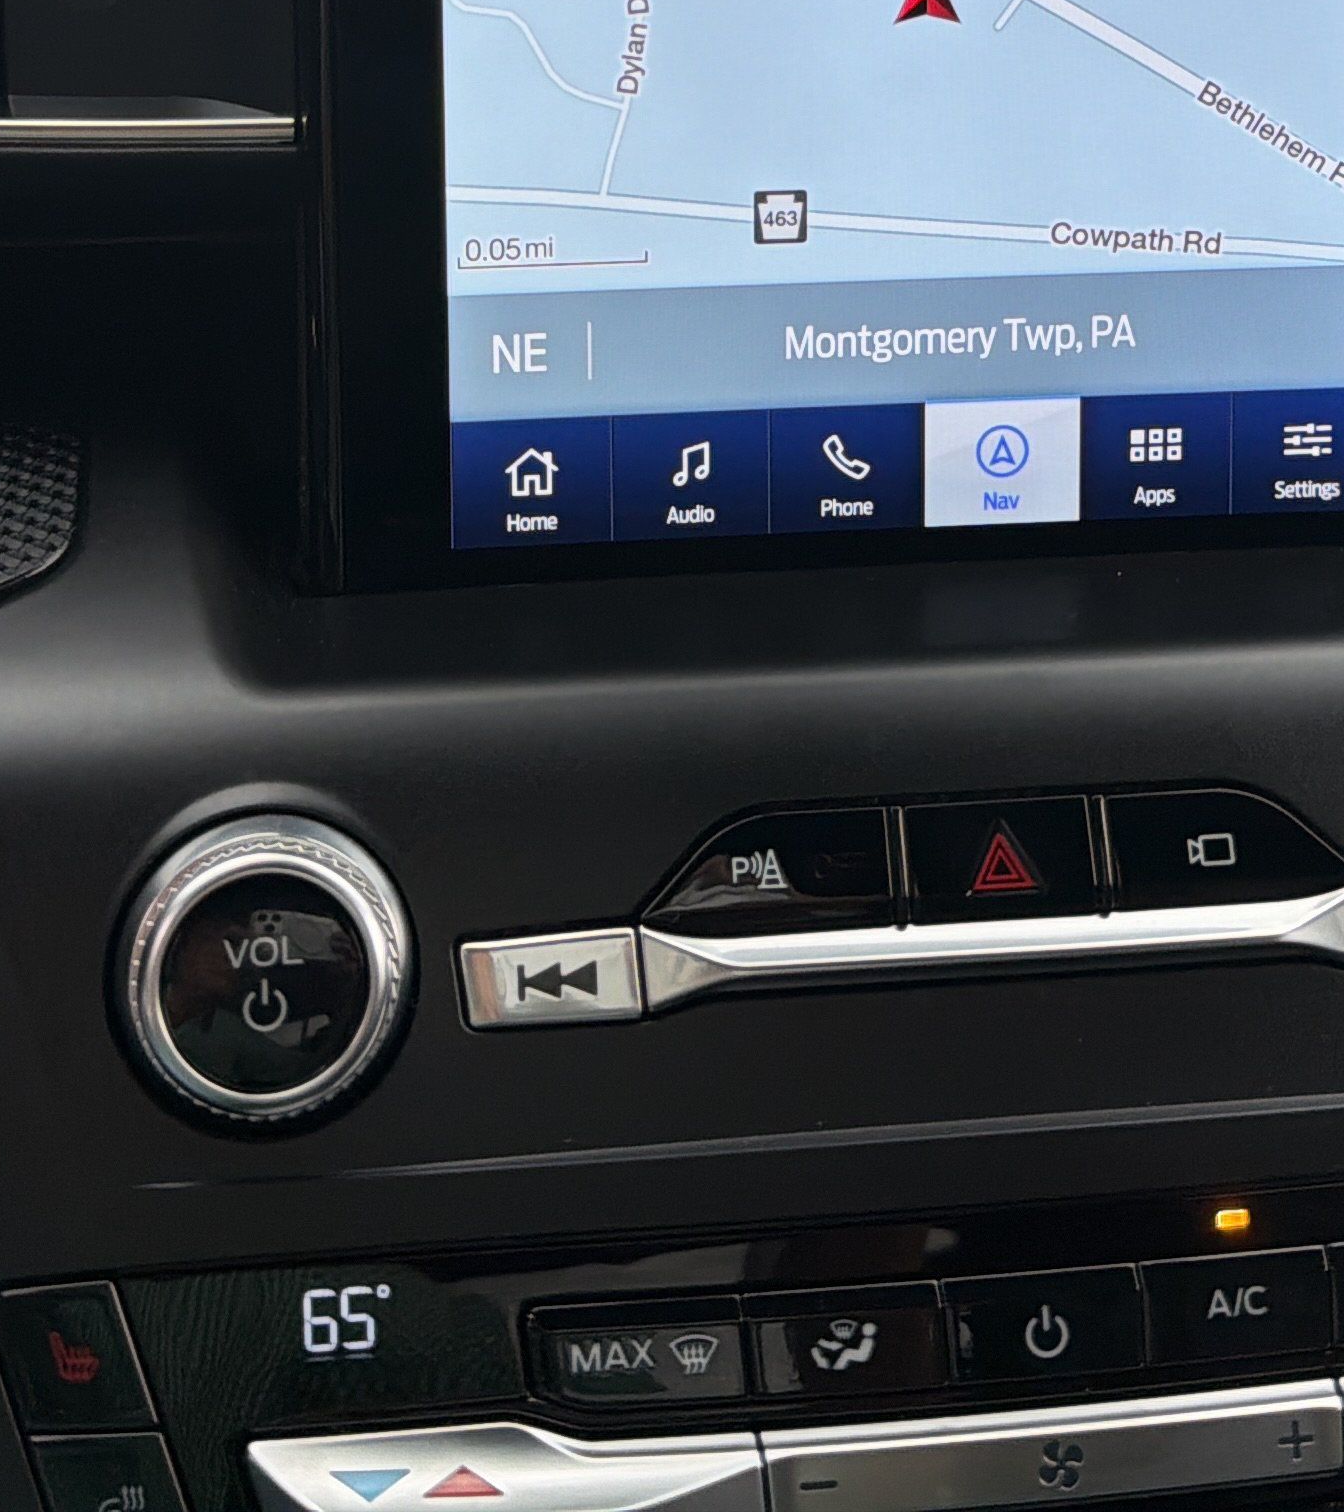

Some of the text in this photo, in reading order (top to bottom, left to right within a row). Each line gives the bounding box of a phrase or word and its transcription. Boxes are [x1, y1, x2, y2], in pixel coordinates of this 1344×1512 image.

[616, 23, 646, 95] Dylan
[1196, 81, 1327, 175] Bethlehem
[763, 210, 798, 228] 463
[464, 236, 554, 262] 0.05 mi
[1050, 221, 1222, 255] Cowpath Rd
[491, 331, 548, 374] NE
[784, 313, 1137, 364] Montgomery Twp, PA
[982, 490, 1021, 511] Nav
[1132, 485, 1176, 507] Apps
[1273, 479, 1341, 501] Settings
[506, 513, 559, 533] Home
[665, 504, 716, 525] Audio
[819, 498, 875, 518] Phone
[222, 934, 305, 969] VOL
[302, 1283, 392, 1354] 65°
[1206, 1285, 1269, 1320] A/C
[570, 1338, 656, 1375] MAX
